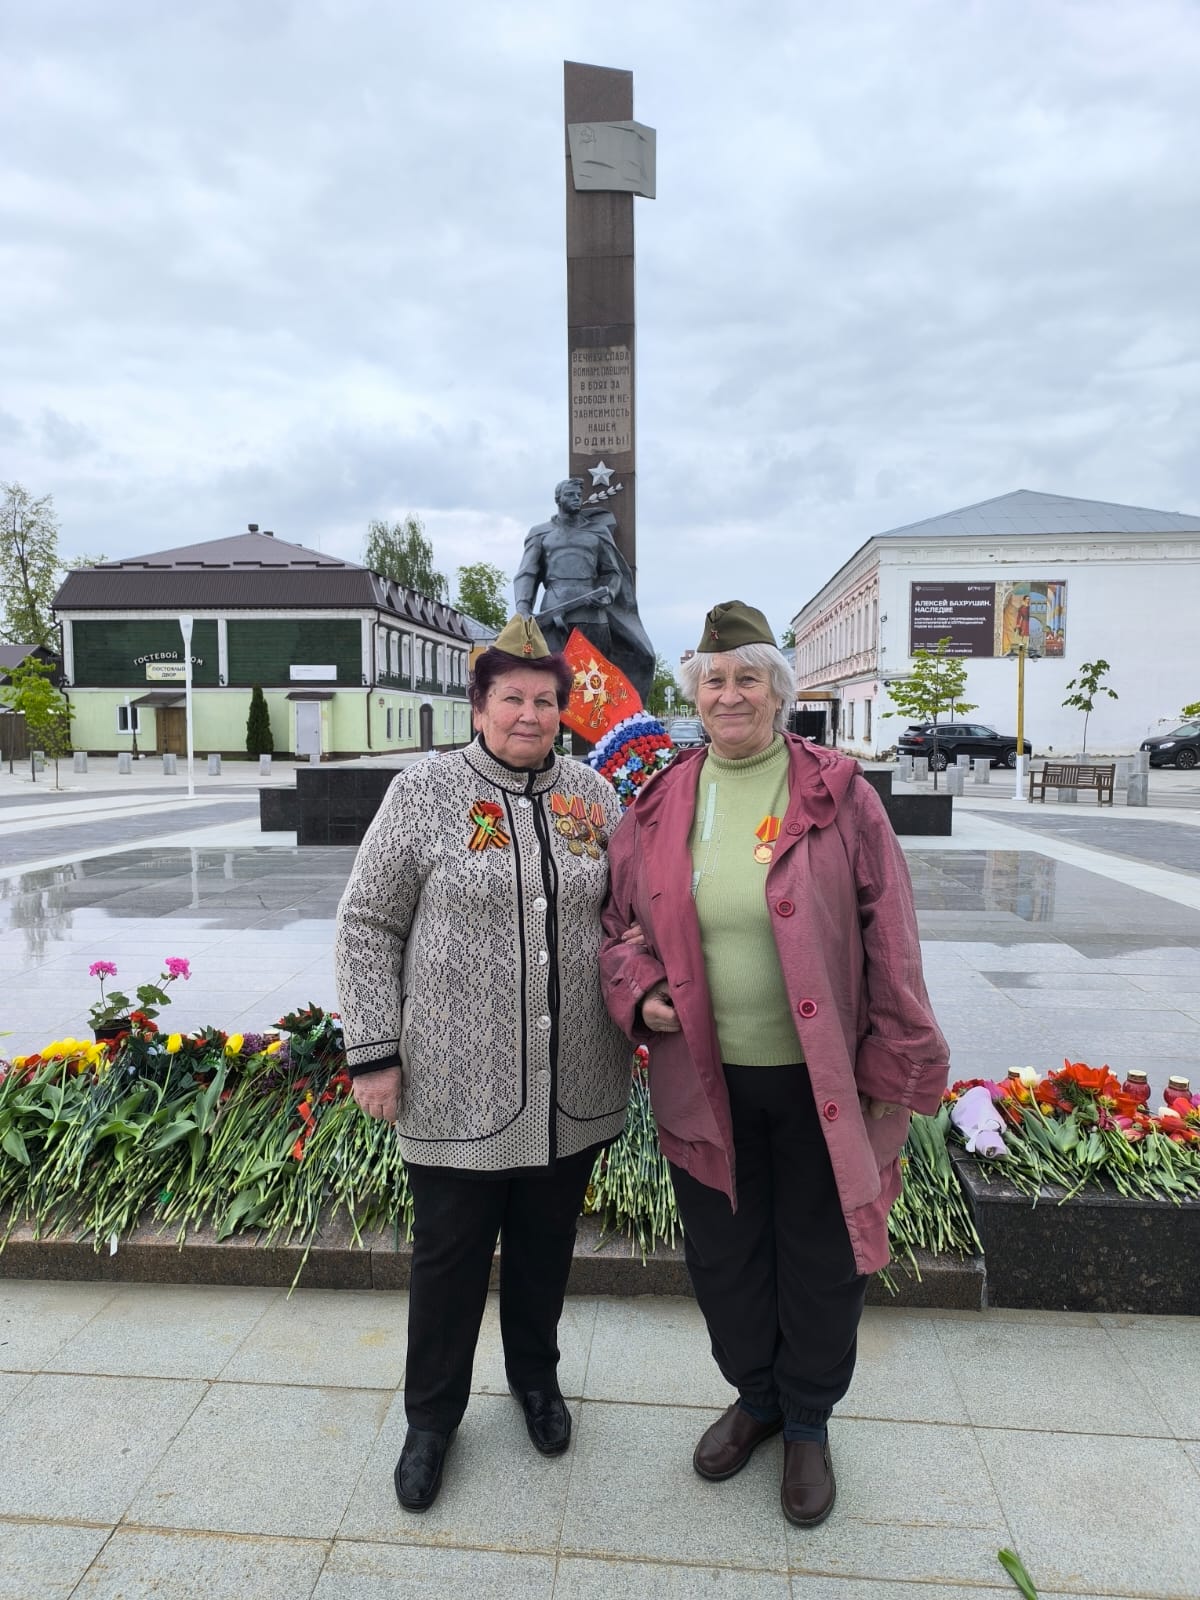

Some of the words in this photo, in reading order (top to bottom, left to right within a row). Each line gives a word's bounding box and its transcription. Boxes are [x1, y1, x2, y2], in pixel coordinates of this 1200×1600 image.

[606, 351, 630, 361] СЛАВА
[580, 382, 585, 390] В
[588, 381, 608, 390] БОЯХ
[610, 381, 620, 389] ЗА
[573, 395, 607, 405] СВОБОДУ
[609, 394, 615, 403] И
[573, 408, 630, 418] ЗАВИСИМОСТЬ
[588, 423, 616, 432] НАШЕЙ
[133, 651, 178, 666] ГОСТЕВОЙ
